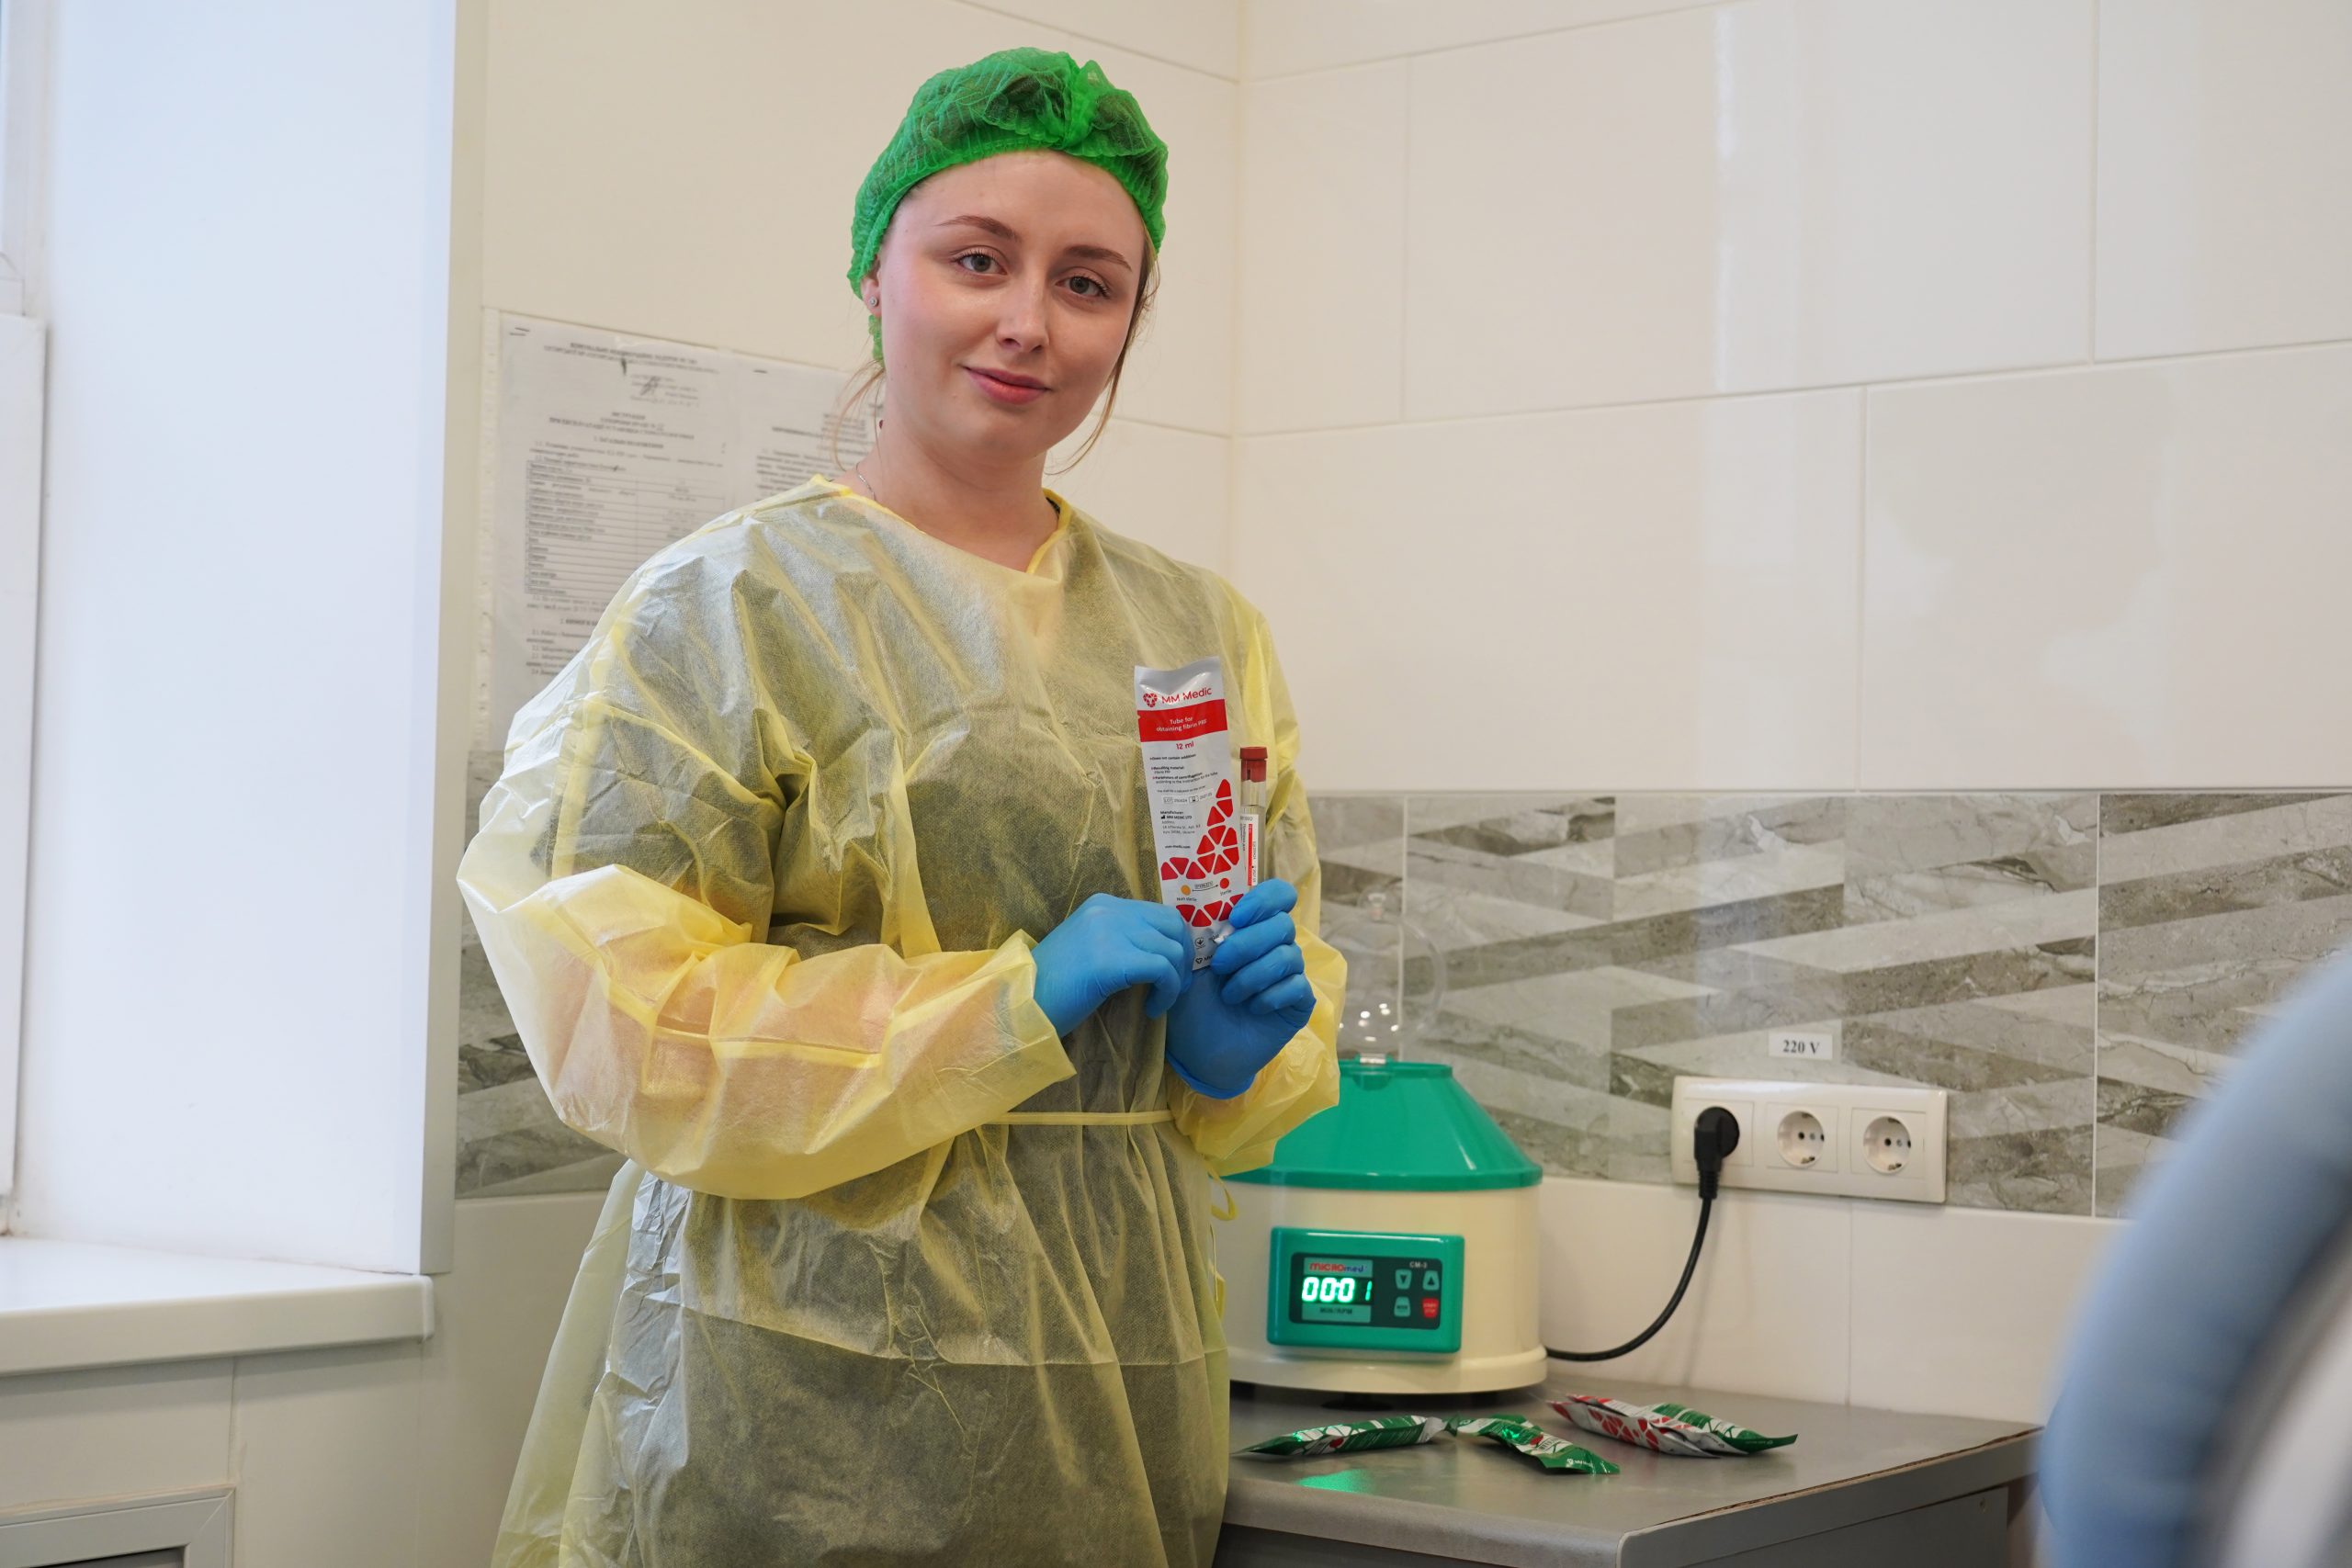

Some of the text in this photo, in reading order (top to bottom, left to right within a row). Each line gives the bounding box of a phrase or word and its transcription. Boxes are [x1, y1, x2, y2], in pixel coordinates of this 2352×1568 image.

[1161, 686, 1213, 704] MM Medic
[1182, 722, 1198, 730] fibrin
[1184, 740, 1194, 749] ml
[1783, 1039, 1820, 1055] 220 V
